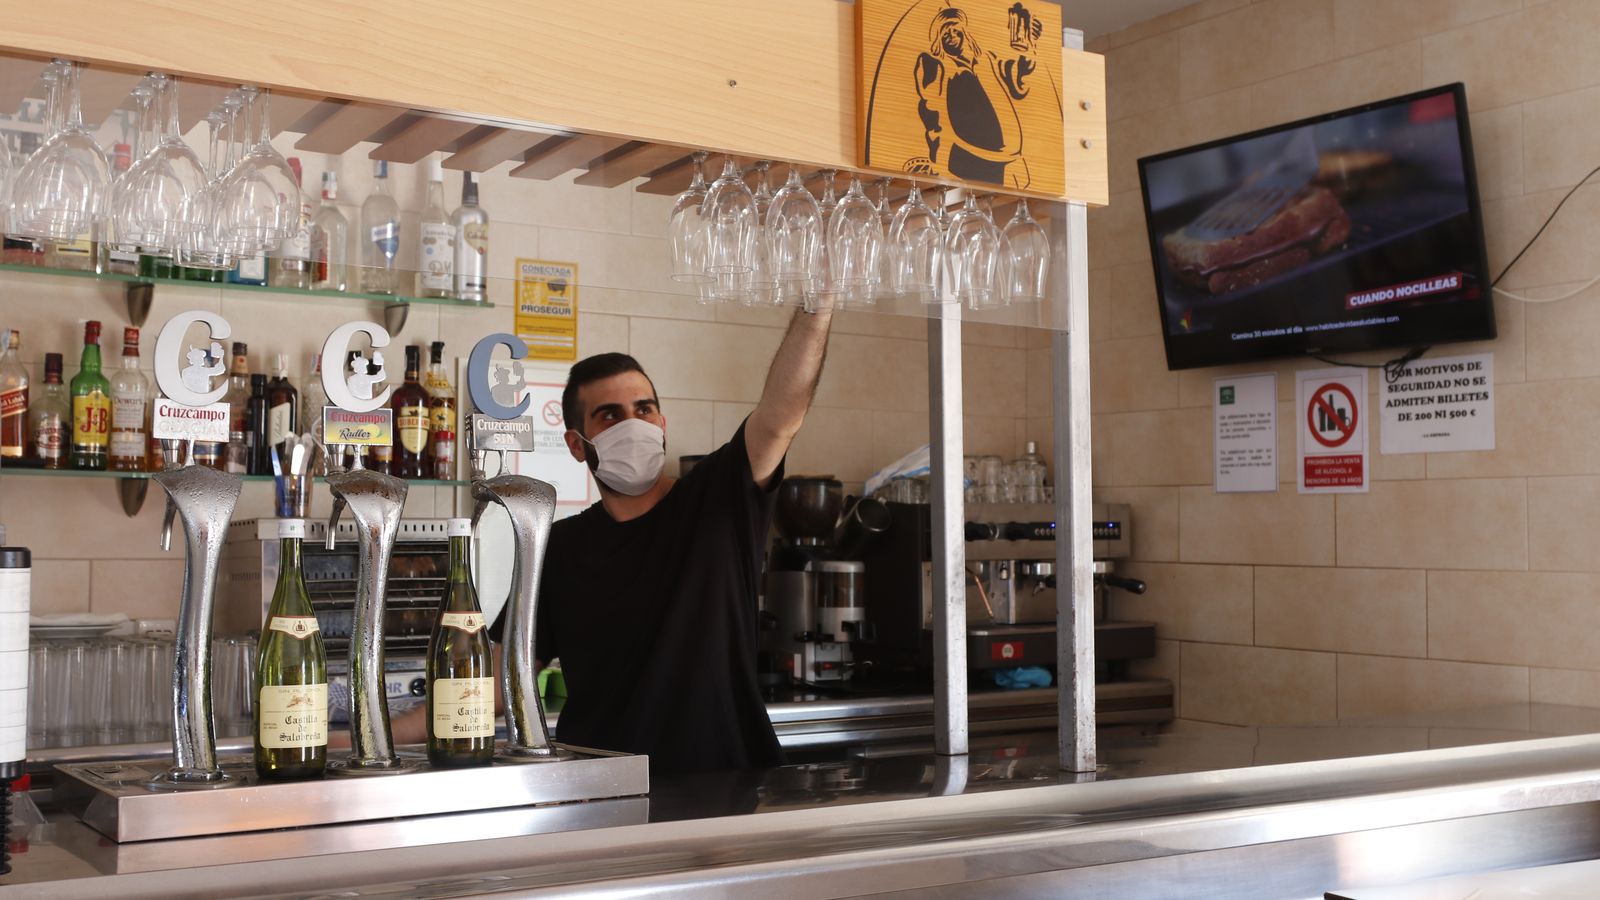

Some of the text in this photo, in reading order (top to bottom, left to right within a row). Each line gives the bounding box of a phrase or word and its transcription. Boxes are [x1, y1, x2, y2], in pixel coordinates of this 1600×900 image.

[521, 264, 571, 275] CONECTADA
[1350, 276, 1458, 307] CUANDO NOCILLEAS
[521, 304, 571, 315] PROSEGUR
[1414, 362, 1465, 376] MOTIVOS
[1467, 361, 1482, 371] DE
[1387, 376, 1487, 393] SEGURIDAD NO SE
[1385, 391, 1489, 408] ADMITEN BILLETES
[159, 404, 226, 422] Cruzcampo
[330, 410, 387, 425] Cruzcampo
[1398, 409, 1476, 422] DE 200 NI 500 €
[477, 418, 531, 433] Cruzcampo
[339, 427, 372, 441] Radler
